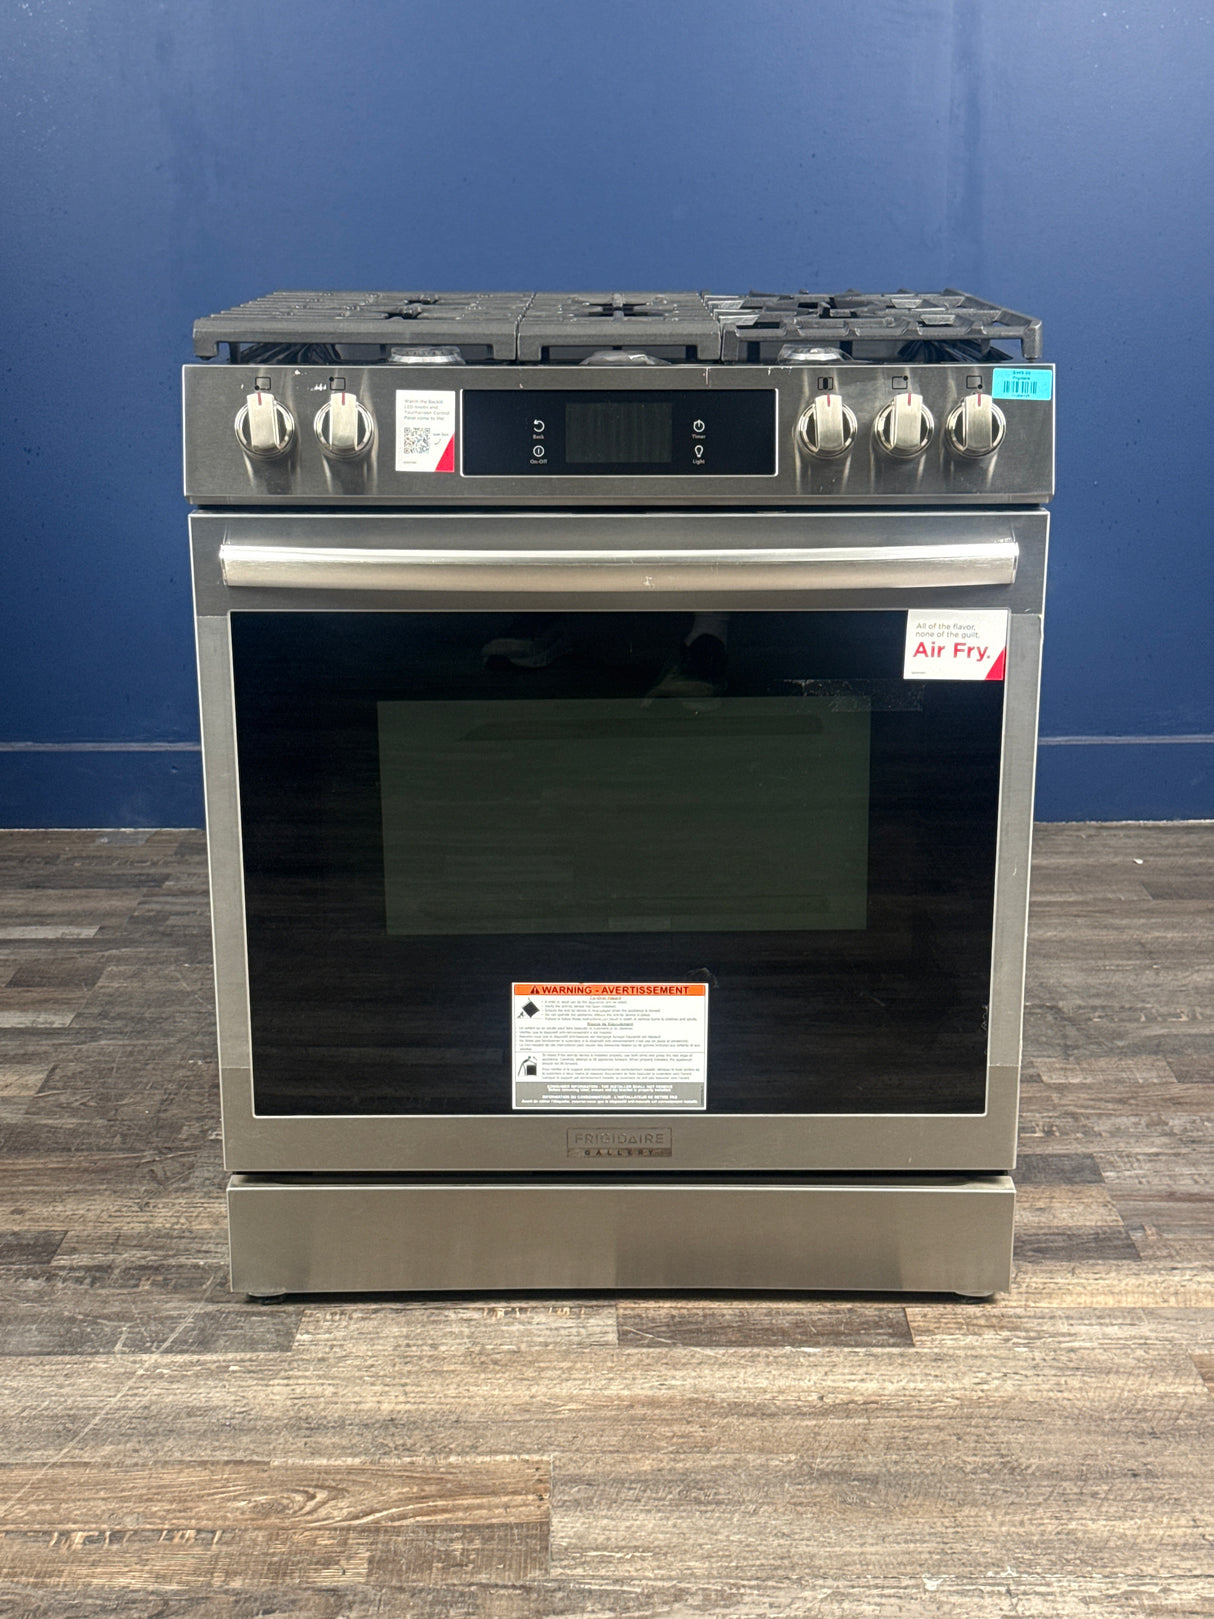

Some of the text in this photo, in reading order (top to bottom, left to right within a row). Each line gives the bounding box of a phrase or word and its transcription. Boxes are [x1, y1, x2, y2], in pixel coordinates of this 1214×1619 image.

[953, 623, 976, 631] flavor,
[913, 641, 990, 662] Air Fry.
[542, 986, 592, 994] WARNING
[601, 986, 689, 994] AVERTISSEMENT
[575, 1133, 665, 1144] FRIGIDAIRE
